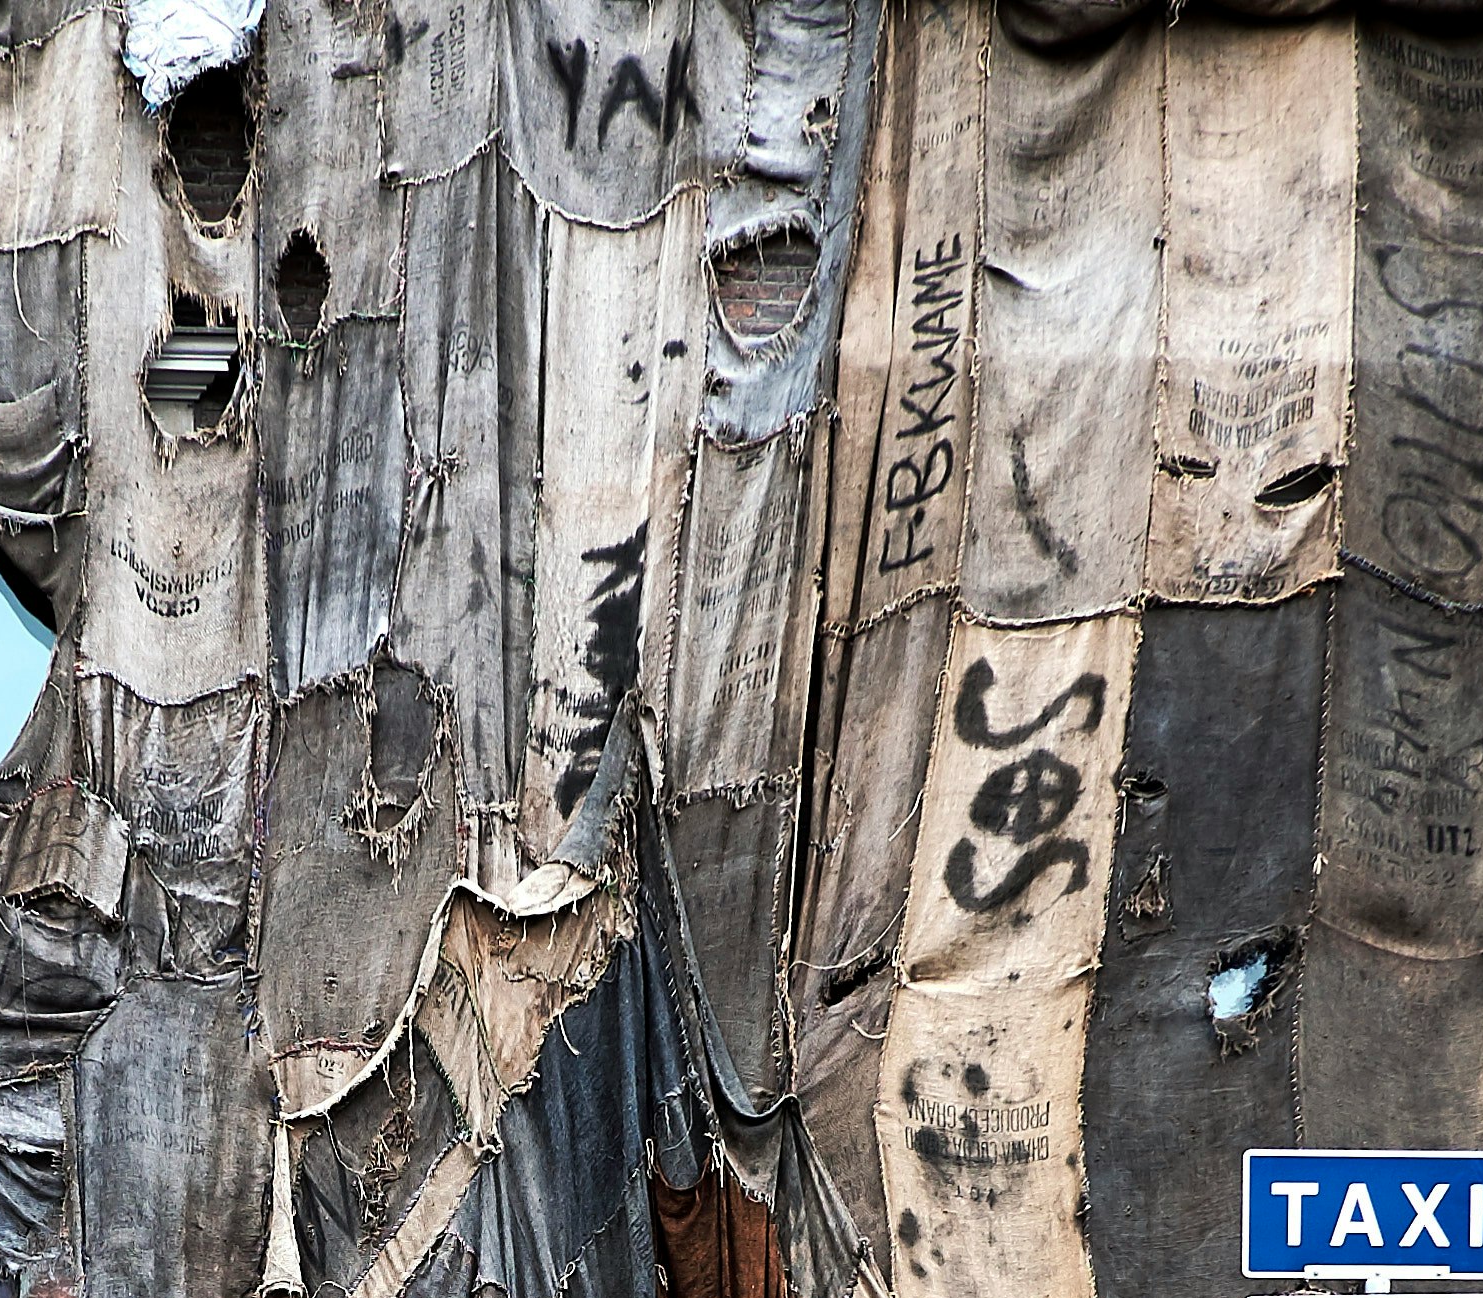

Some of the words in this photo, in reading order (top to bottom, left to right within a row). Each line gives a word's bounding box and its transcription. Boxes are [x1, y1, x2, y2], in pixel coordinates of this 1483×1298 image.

[133, 580, 200, 619] COCOA
[977, 1101, 1051, 1133] PRODUCE
[1271, 1182, 1483, 1248] TAXI
